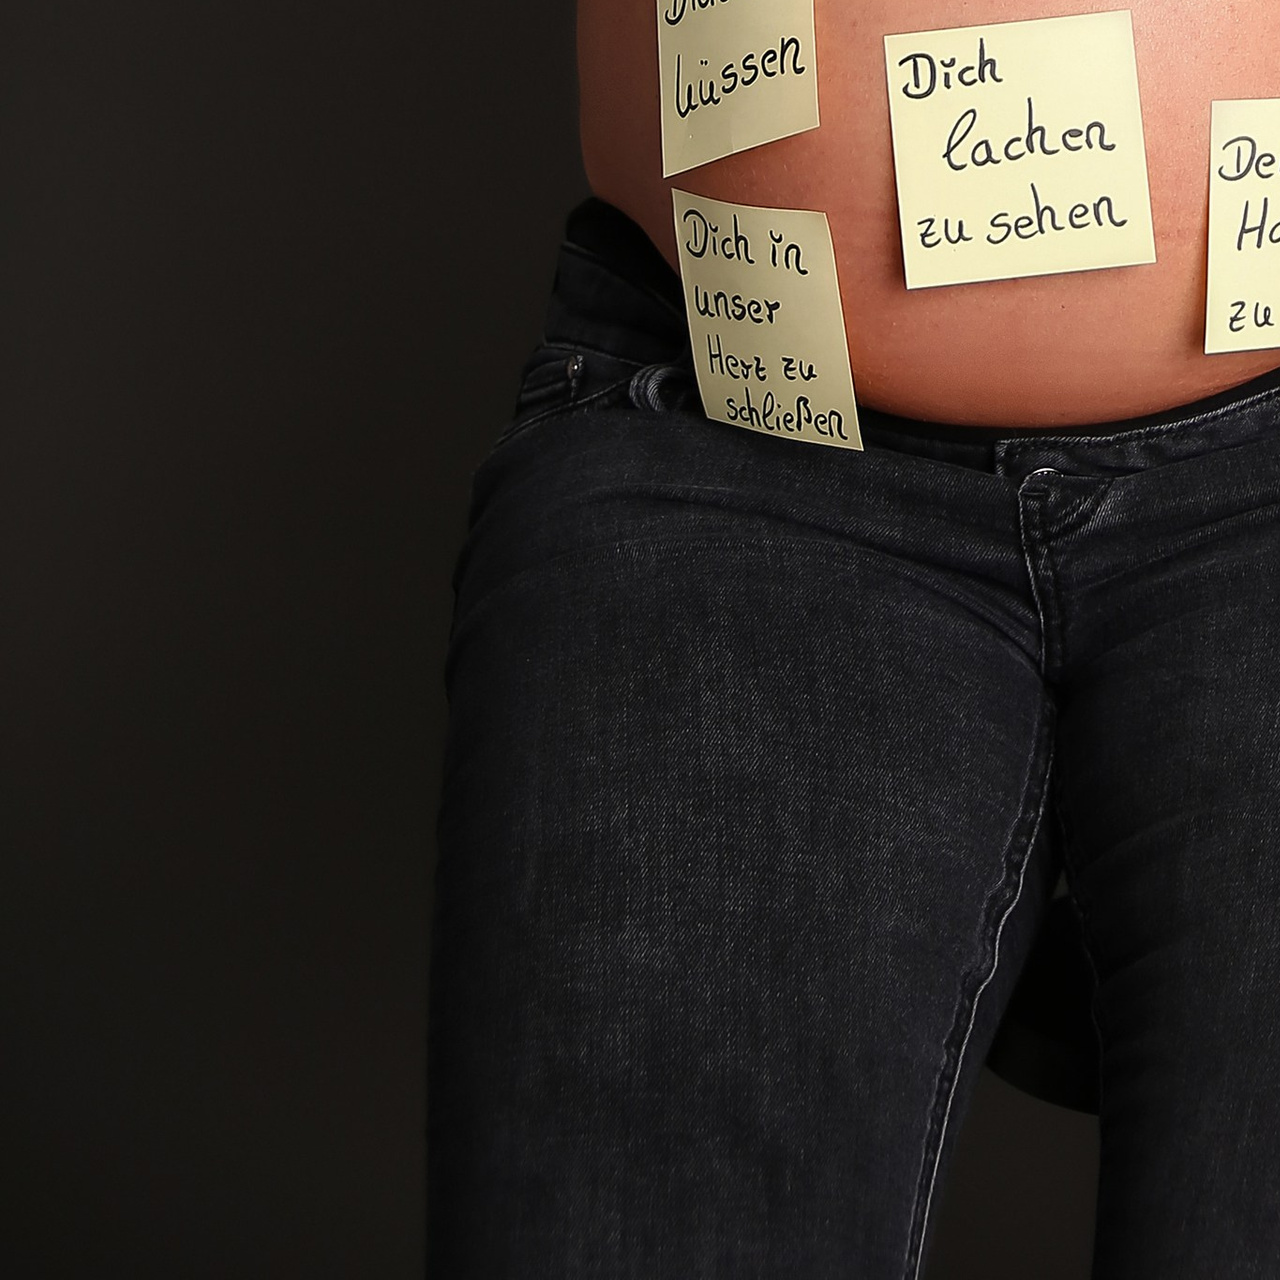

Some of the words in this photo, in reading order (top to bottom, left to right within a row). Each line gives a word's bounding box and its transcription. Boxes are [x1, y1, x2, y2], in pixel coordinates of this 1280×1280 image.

[898, 37, 1003, 100] Dich
[942, 96, 1116, 172] lachen
[683, 209, 755, 265] Dich
[769, 229, 809, 276] in
[917, 217, 973, 249] zu
[986, 182, 1128, 245] sehen
[694, 285, 781, 324] unser
[1228, 300, 1275, 333] zu
[707, 333, 767, 382] Herz
[781, 356, 818, 382] zu
[726, 386, 848, 441] schließen
